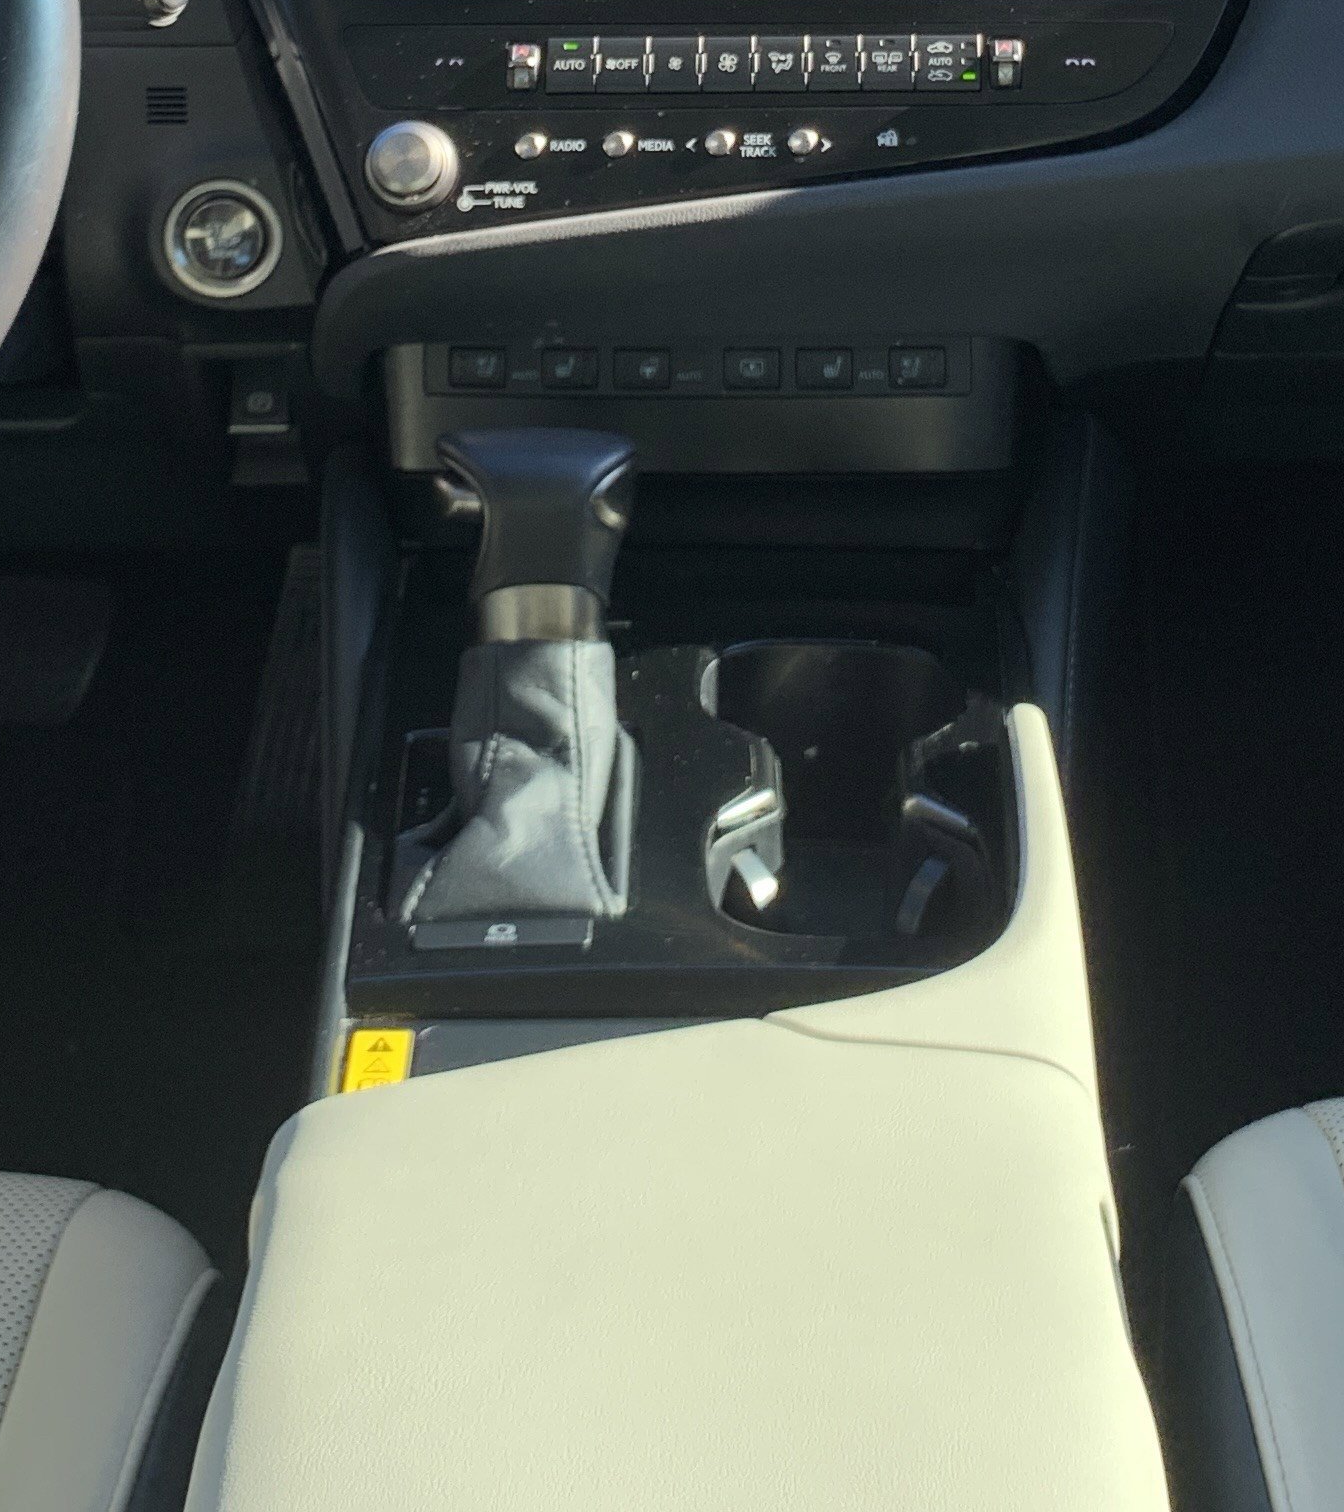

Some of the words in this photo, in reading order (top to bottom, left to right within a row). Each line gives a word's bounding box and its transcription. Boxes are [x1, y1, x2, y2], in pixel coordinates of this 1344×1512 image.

[552, 59, 587, 71] AUTO
[617, 59, 640, 70] OFF
[820, 63, 848, 74] FRONT
[928, 57, 953, 68] AUTO
[549, 139, 588, 153] RADIO
[637, 139, 676, 153] MEDIA
[742, 134, 774, 146] SEEK
[738, 146, 777, 159] TRACK
[492, 196, 526, 209] TUNE
